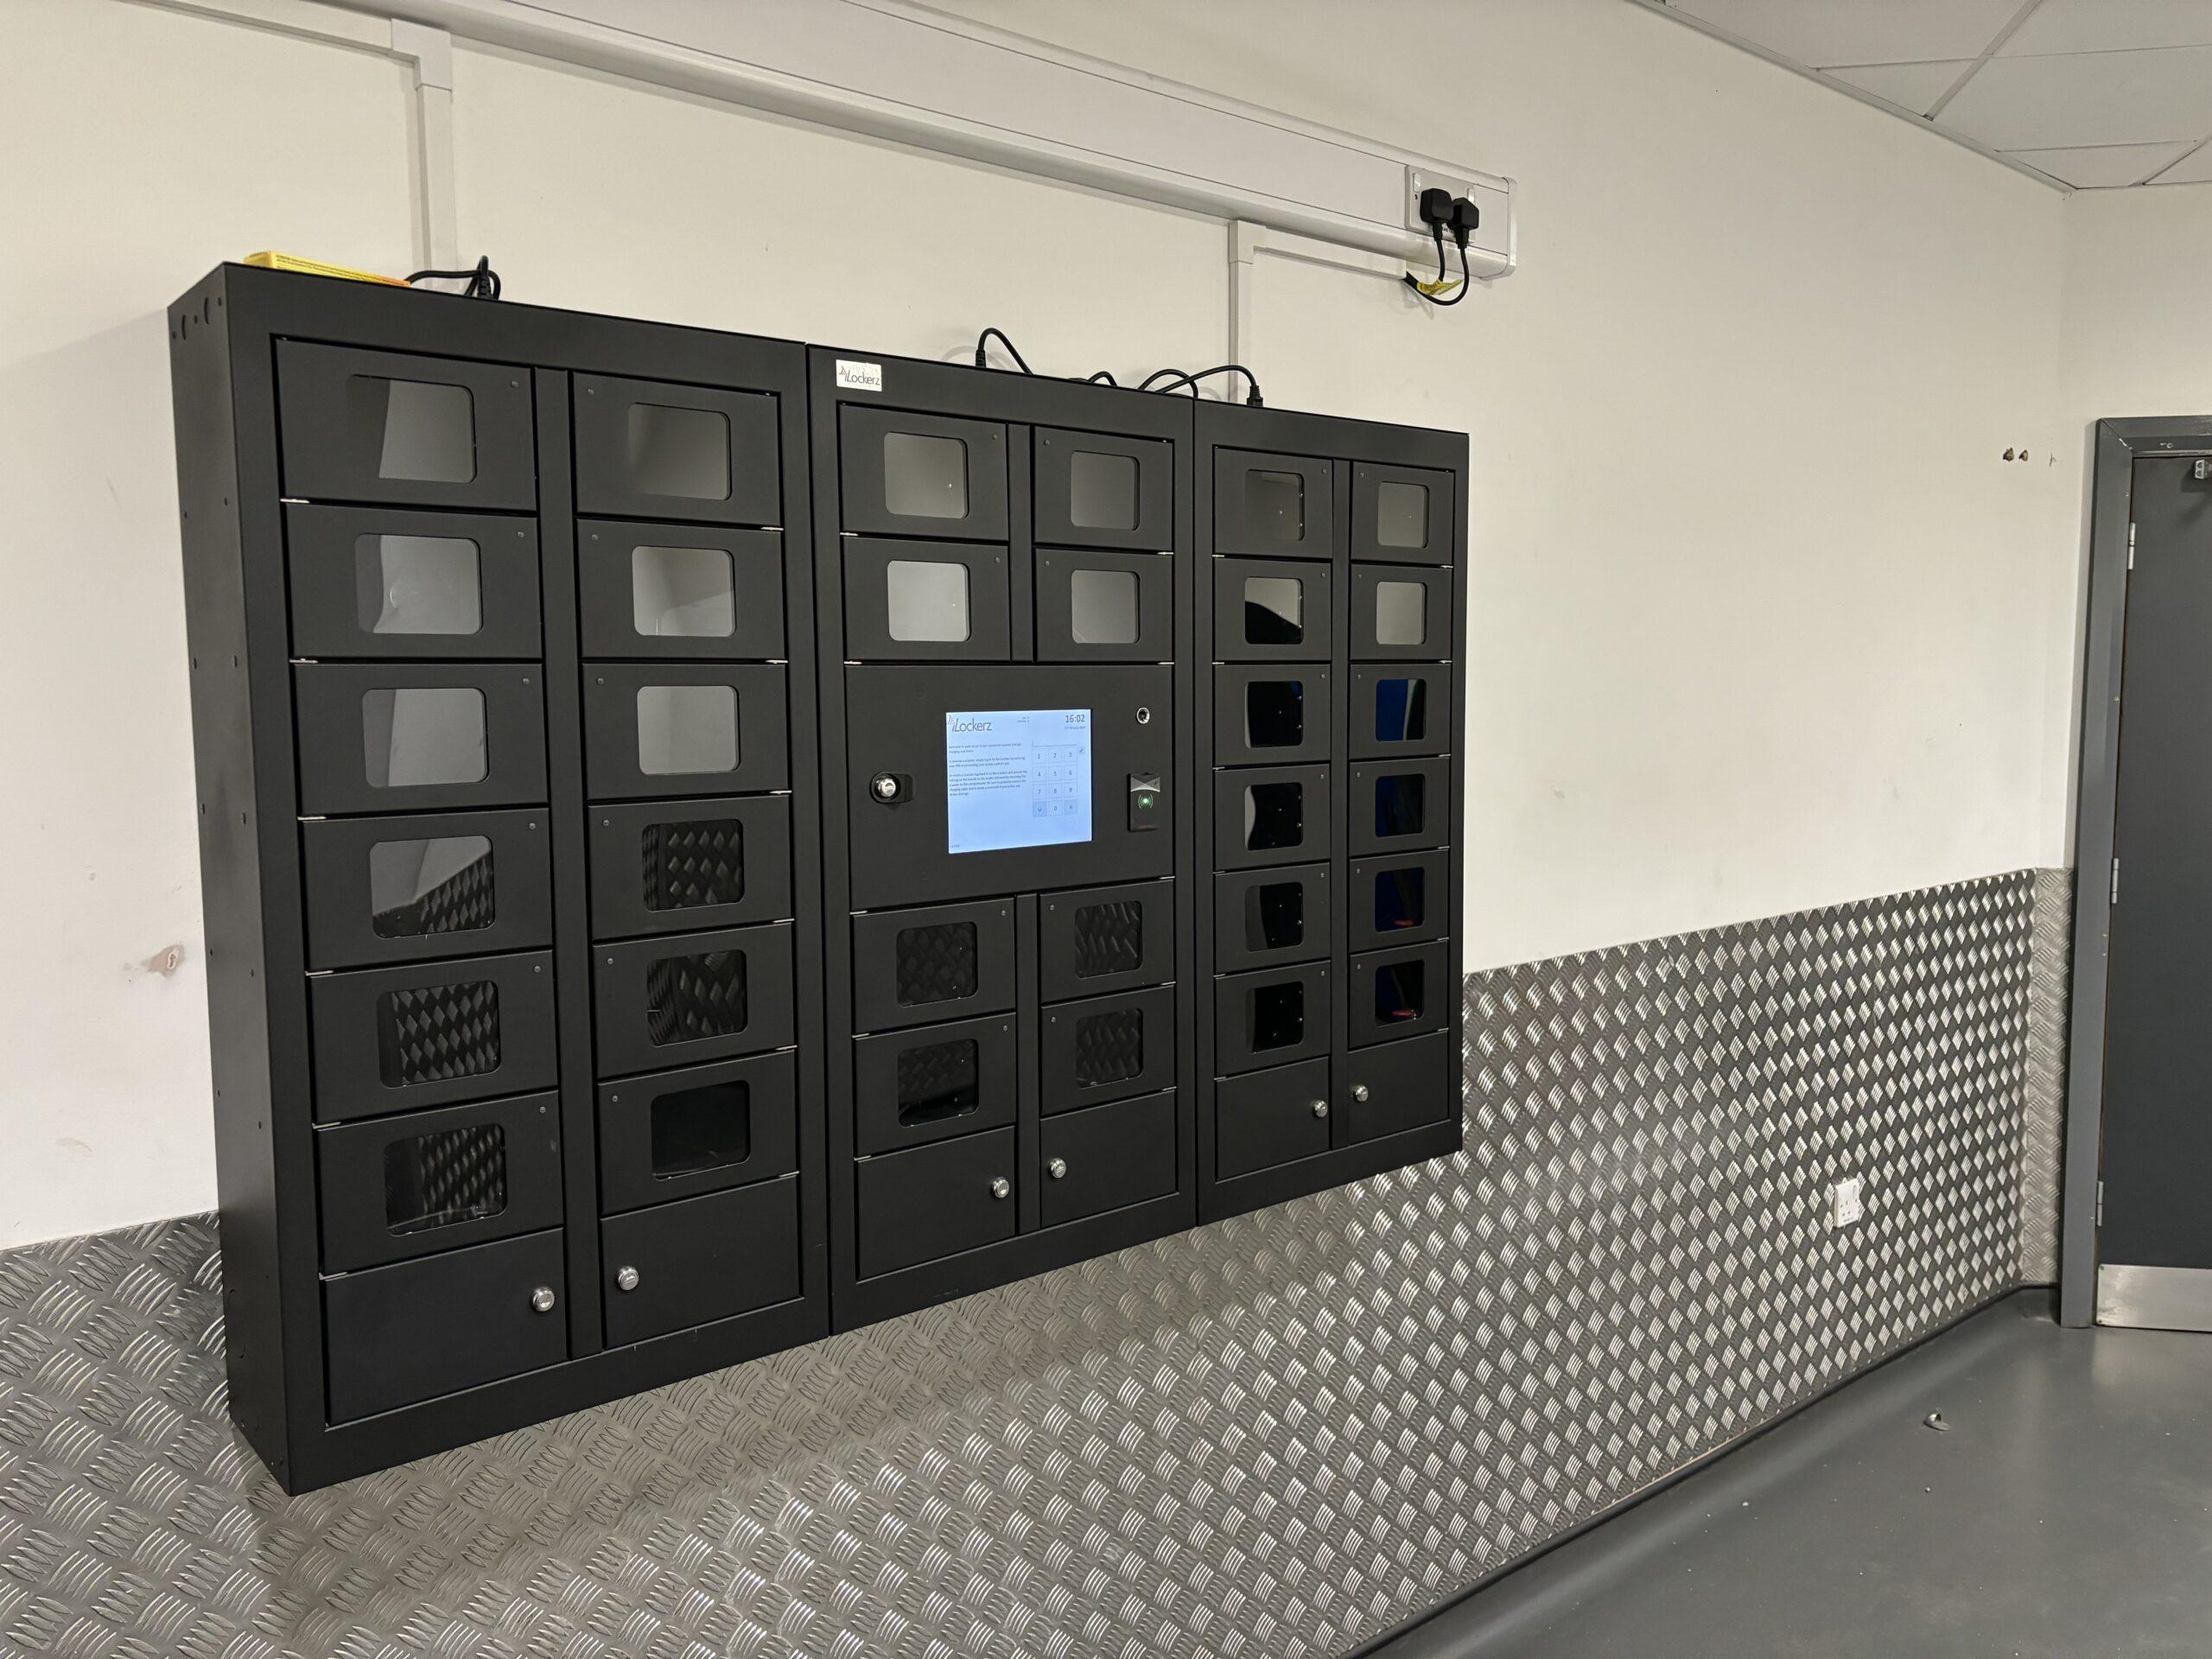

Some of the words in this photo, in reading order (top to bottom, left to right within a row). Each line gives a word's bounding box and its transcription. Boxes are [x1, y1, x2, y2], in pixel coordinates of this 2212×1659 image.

[844, 370, 880, 385] iLockerz
[951, 717, 992, 732] iLockerz
[1065, 714, 1085, 723] 16:02
